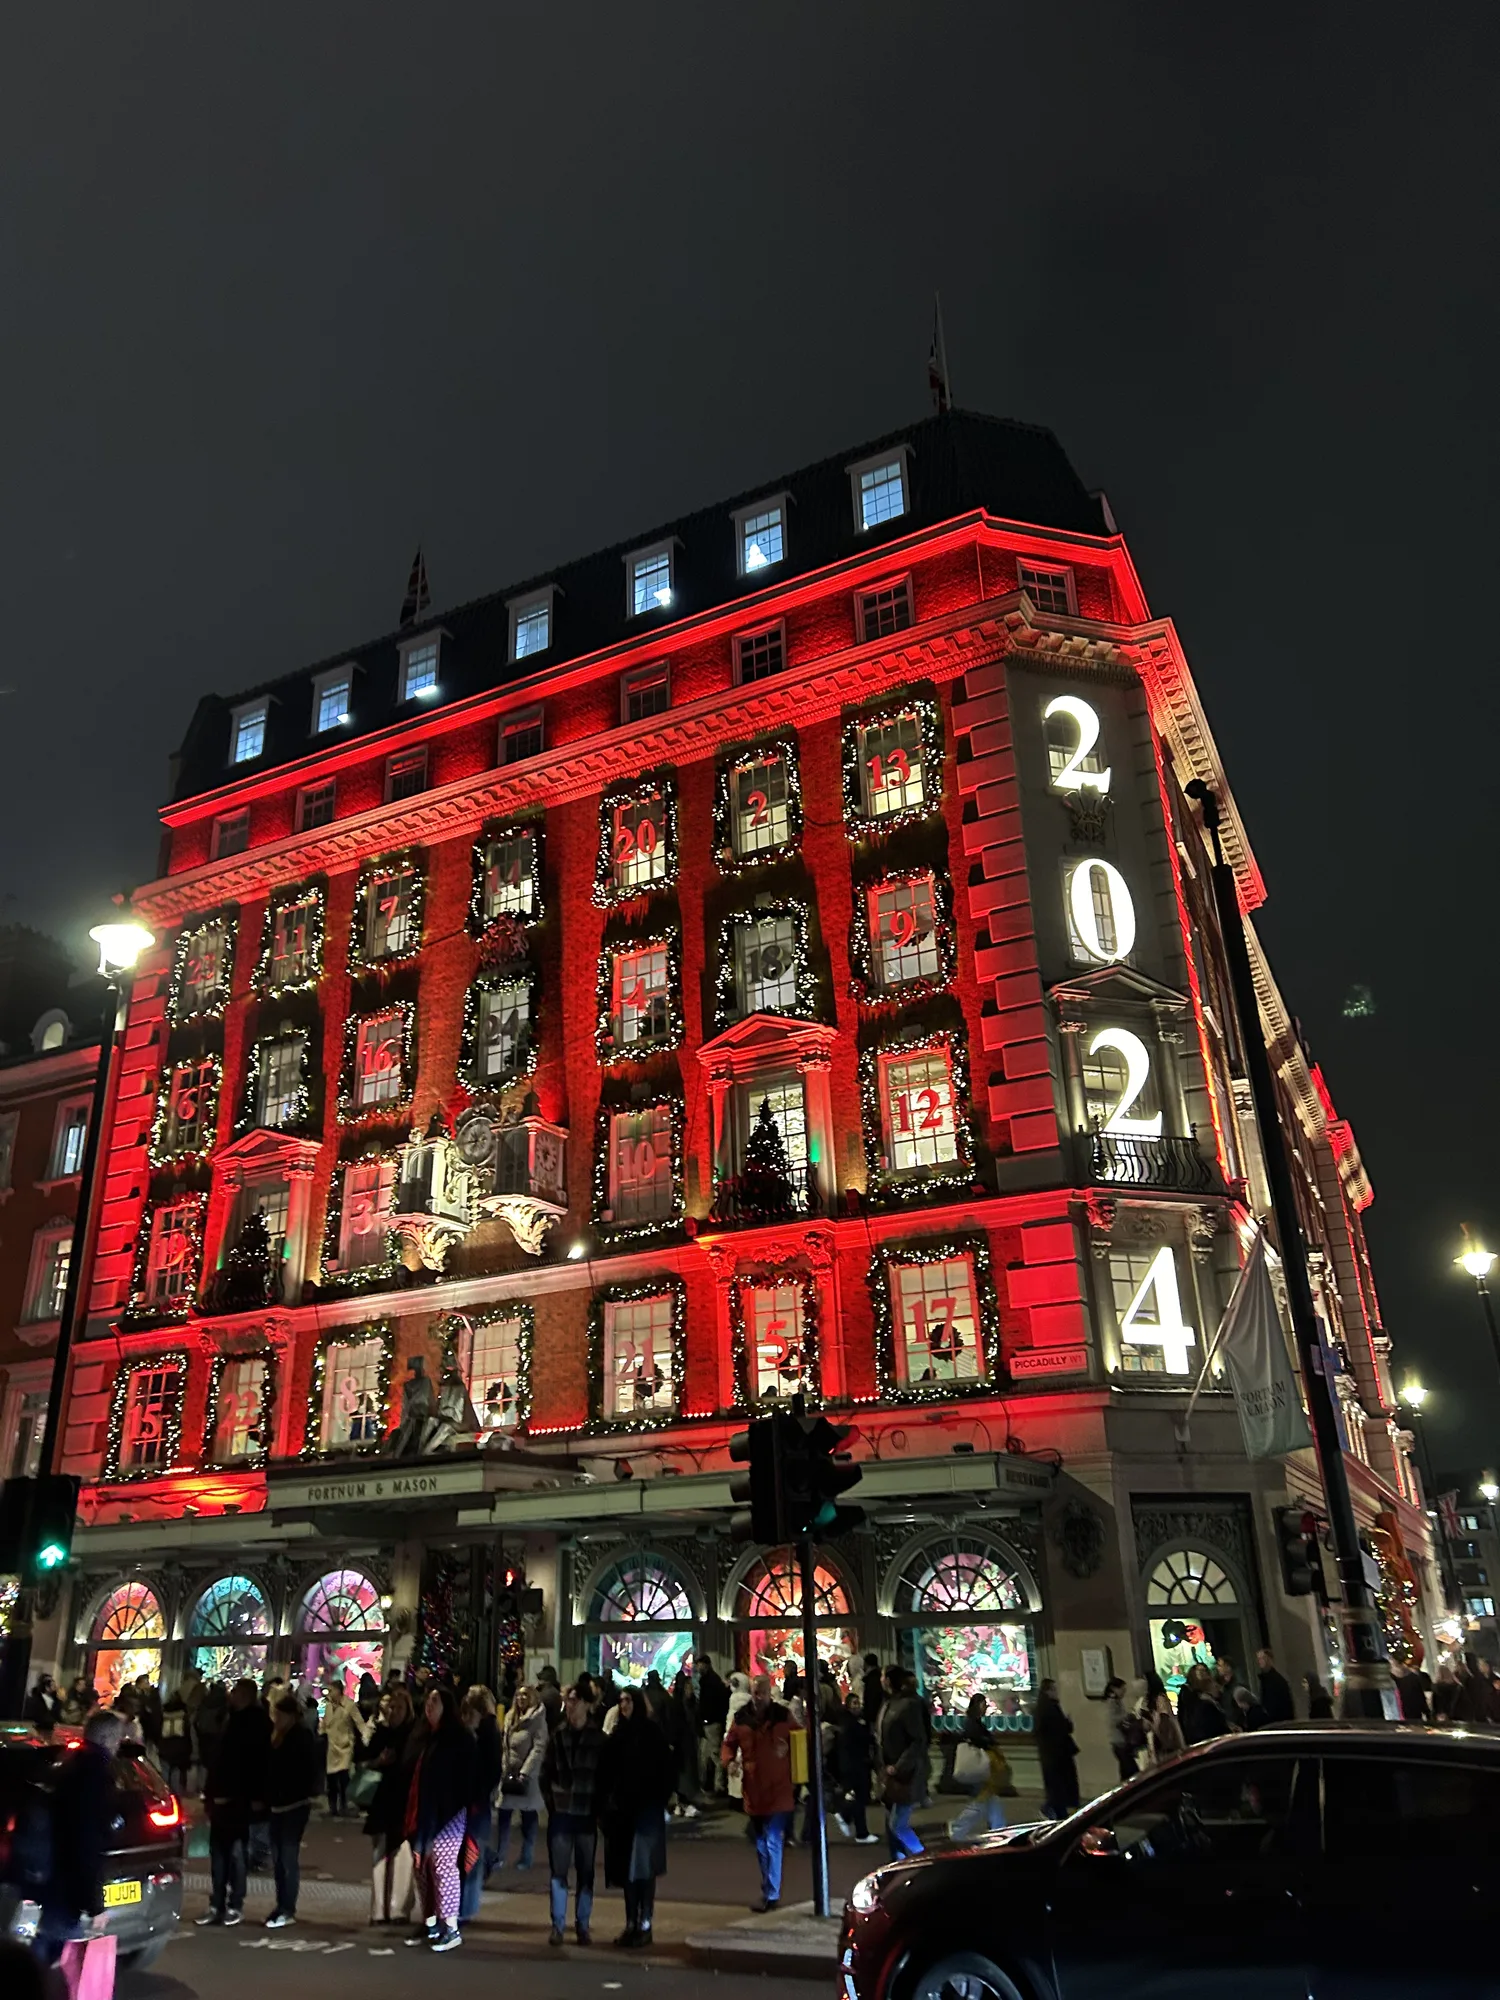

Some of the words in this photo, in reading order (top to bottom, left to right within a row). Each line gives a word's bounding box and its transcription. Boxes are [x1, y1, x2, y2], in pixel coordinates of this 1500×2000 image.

[867, 749, 911, 791] 13
[748, 790, 769, 826] 2
[617, 819, 656, 862] 20
[379, 896, 399, 928] 7
[889, 911, 914, 950] 9
[274, 924, 307, 960] 11
[745, 945, 786, 983] 18
[621, 978, 648, 1010] 4
[484, 1009, 519, 1046] 24
[361, 1039, 396, 1078] 16
[177, 1087, 198, 1120] 6
[898, 1089, 943, 1132] 12
[619, 1140, 657, 1184] 10
[354, 1199, 374, 1235] 3
[154, 1233, 188, 1270] 19
[907, 1297, 957, 1343] 17
[617, 1336, 654, 1382] 21
[763, 1320, 788, 1364] 5
[1014, 1356, 1067, 1369] PICCADILLY
[339, 1377, 359, 1413] 8
[1240, 1380, 1287, 1402] ORTUM
[128, 1402, 163, 1440] 15
[219, 1391, 258, 1430] 22
[308, 1483, 366, 1501] FORTNUM
[376, 1482, 384, 1495] &
[393, 1476, 438, 1494] MASON
[115, 1884, 137, 1901] JUH
